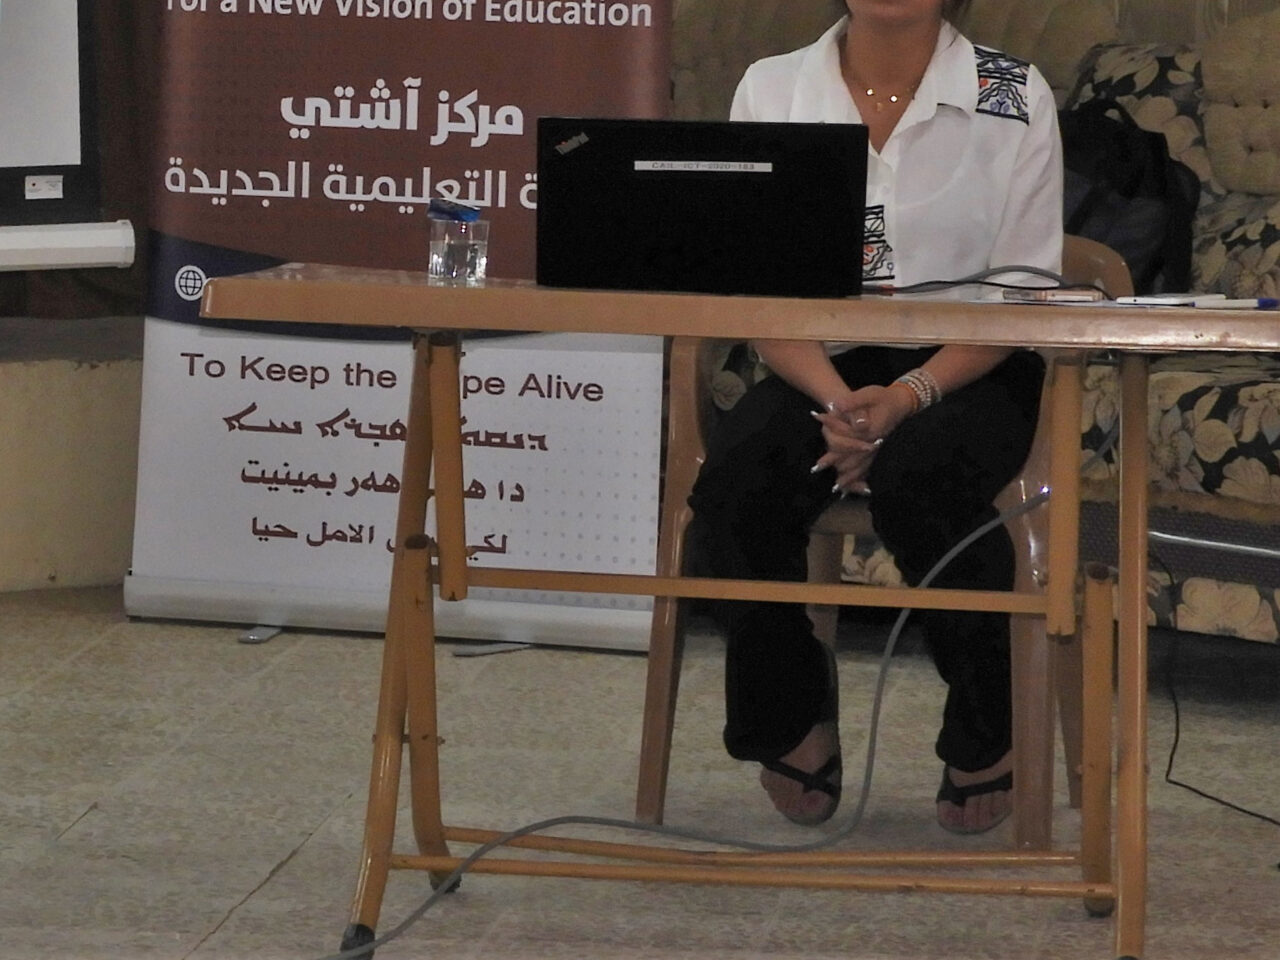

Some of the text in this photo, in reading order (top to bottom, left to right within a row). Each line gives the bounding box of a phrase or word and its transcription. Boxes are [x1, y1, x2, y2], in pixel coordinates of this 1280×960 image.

[280, 76, 524, 148] مركز آشتي
[164, 156, 310, 208] الجديدة
[322, 163, 507, 214] التعليمية
[180, 352, 226, 379] To
[240, 355, 330, 390] Keep
[342, 362, 397, 389] the
[517, 373, 604, 402] Alive
[498, 479, 525, 502] دا
[251, 516, 299, 542] حيا
[305, 521, 375, 547] الامل
